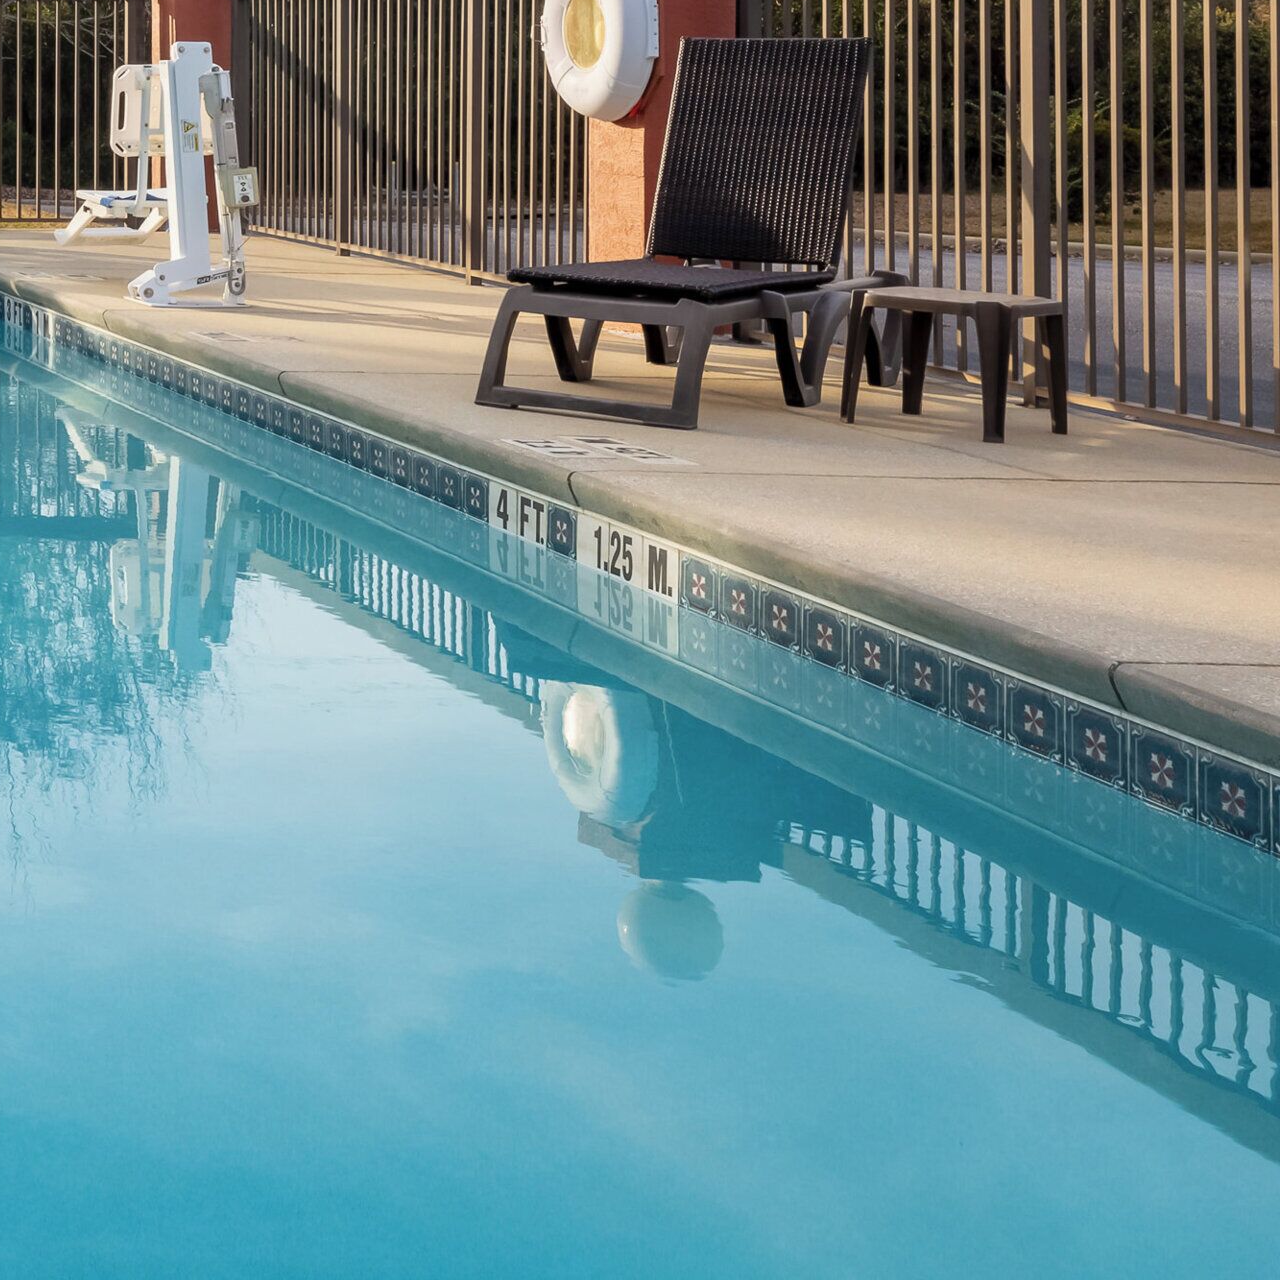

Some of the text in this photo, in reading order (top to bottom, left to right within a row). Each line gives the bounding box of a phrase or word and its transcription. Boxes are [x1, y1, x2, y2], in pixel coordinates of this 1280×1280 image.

[496, 489, 545, 545] 4 FT.
[593, 525, 673, 598] 1.25 M.
